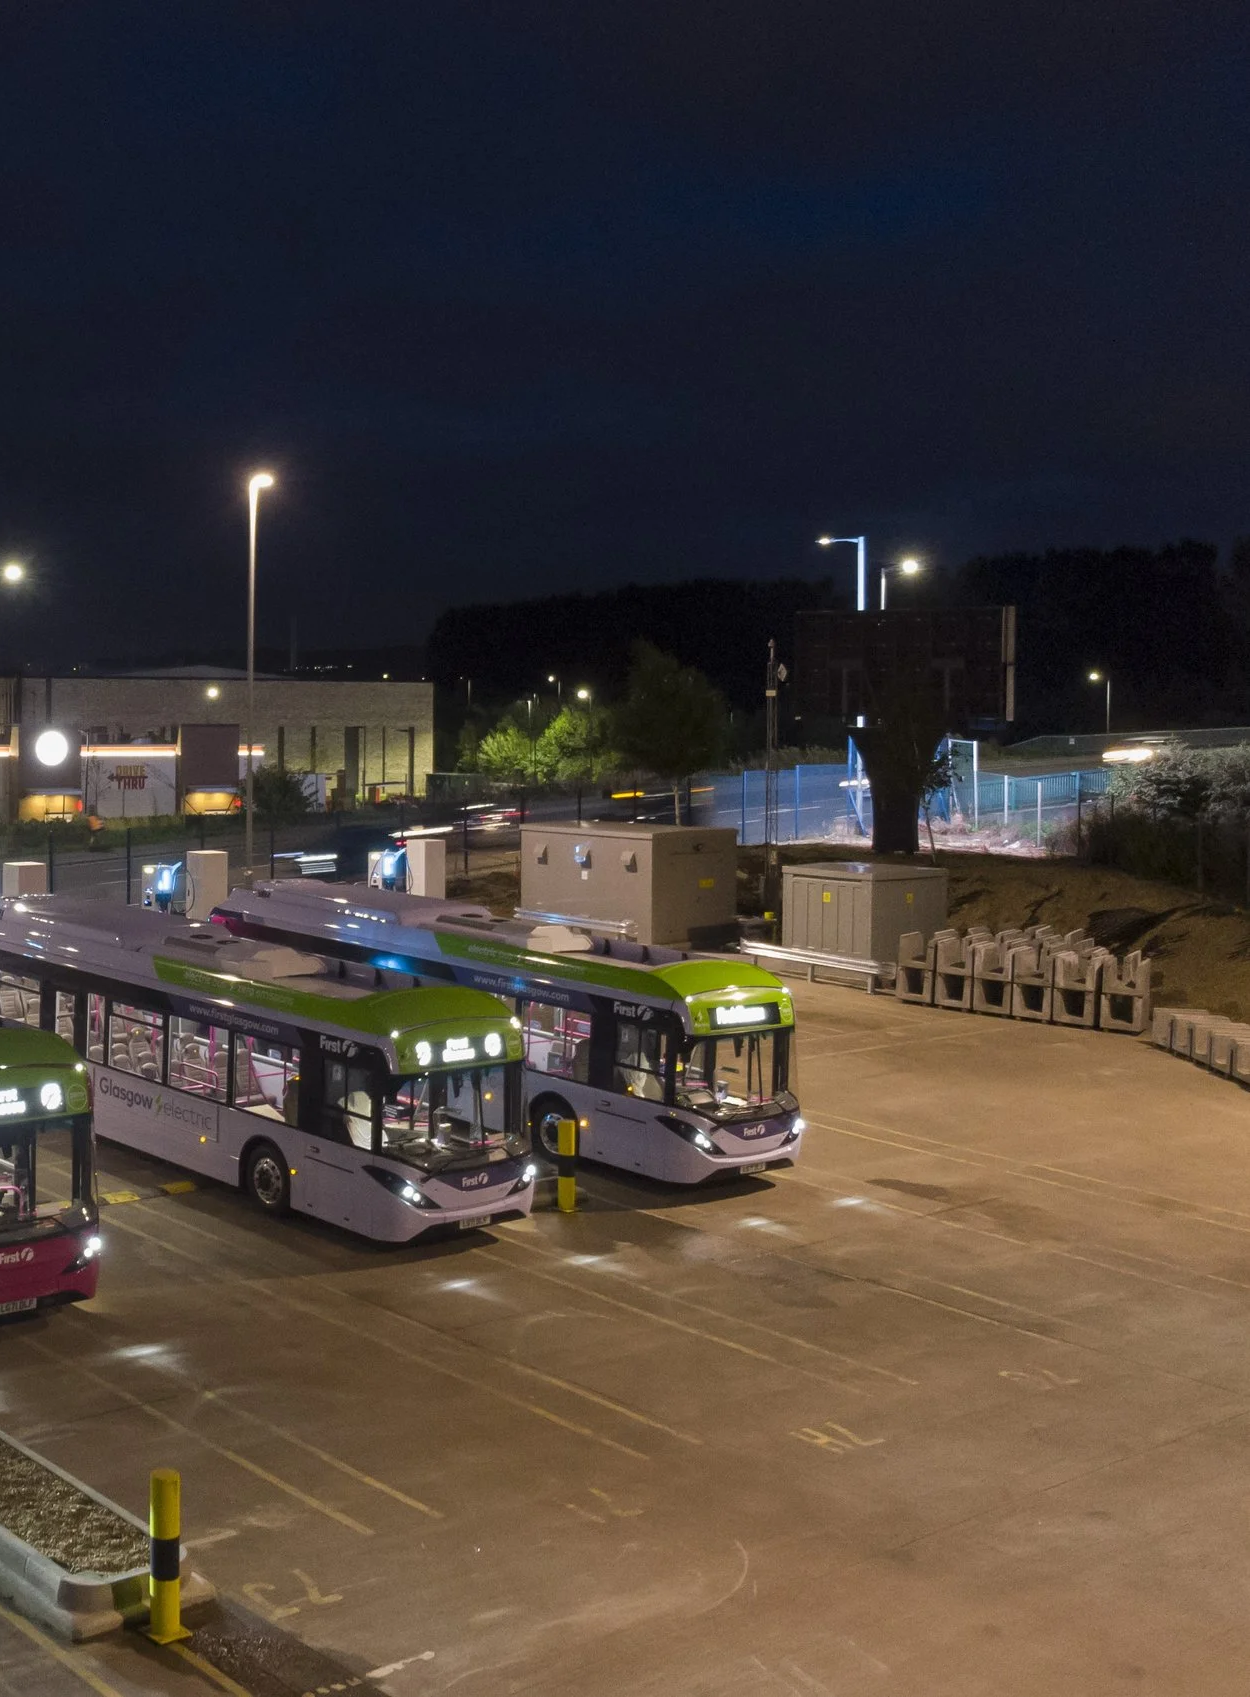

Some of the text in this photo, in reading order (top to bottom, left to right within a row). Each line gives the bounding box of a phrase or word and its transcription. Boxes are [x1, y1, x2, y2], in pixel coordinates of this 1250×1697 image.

[116, 765, 146, 776] DRIVE
[117, 776, 146, 789] THRU
[472, 974, 570, 1002] www.firstglasgow.com
[613, 1001, 636, 1018] First
[189, 1003, 280, 1036] www.firstglasgow.com
[319, 1035, 341, 1054] First
[99, 1077, 213, 1131] Glasgow electric
[743, 1127, 757, 1137] First
[461, 1176, 479, 1188] First
